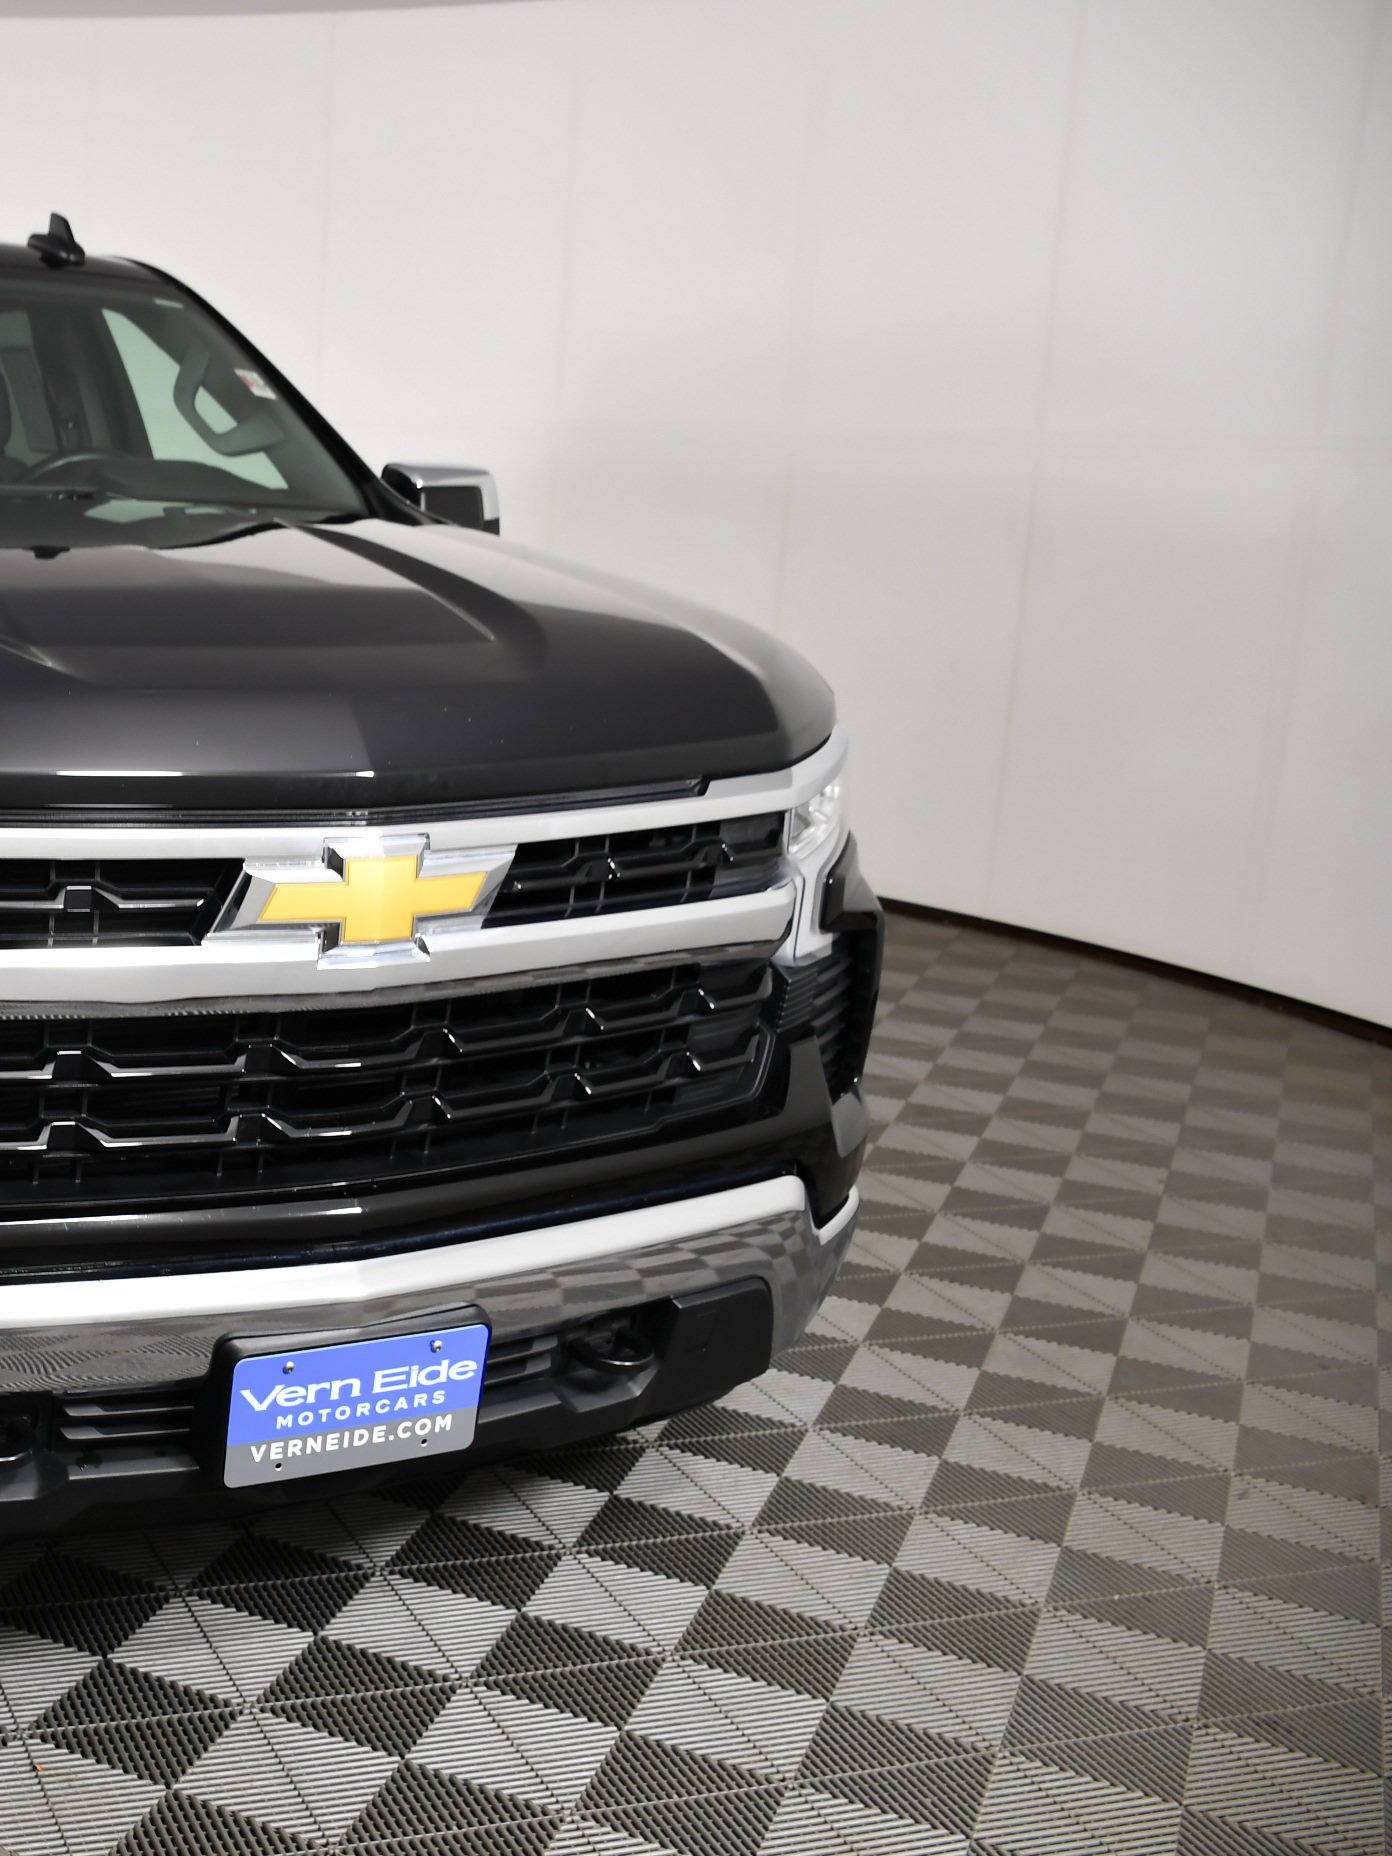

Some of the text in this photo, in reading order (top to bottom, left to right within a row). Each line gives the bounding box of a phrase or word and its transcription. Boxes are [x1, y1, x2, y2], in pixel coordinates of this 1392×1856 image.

[240, 1359, 479, 1411] Vern Eide
[275, 1390, 446, 1429] MOTORCARS
[250, 1414, 453, 1463] VERNEIDE.COM
